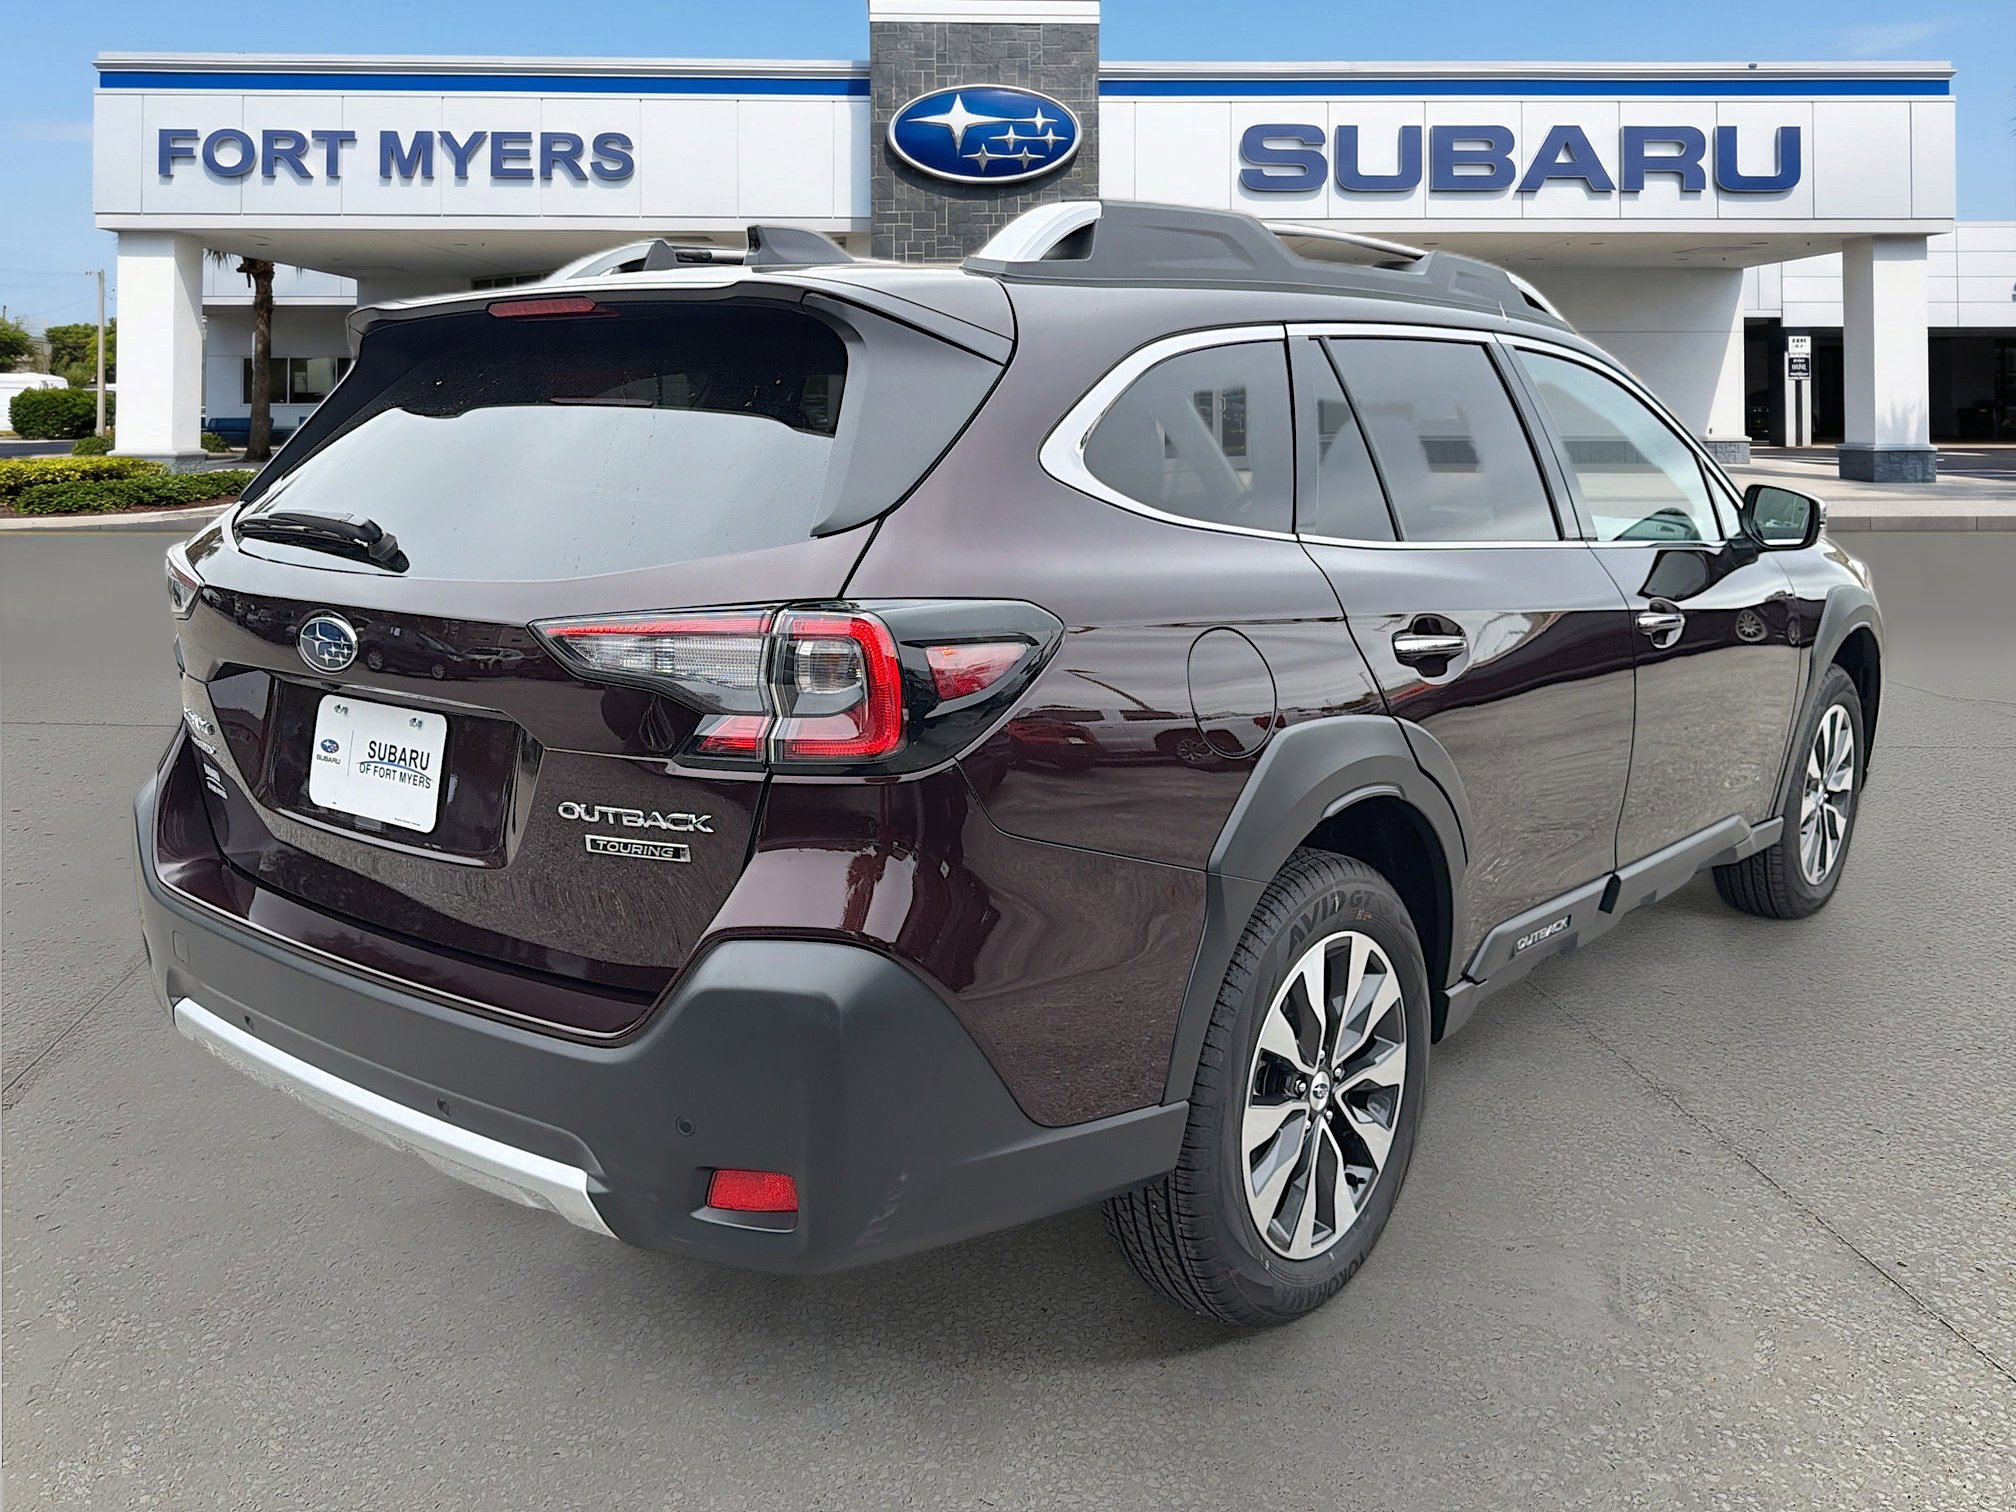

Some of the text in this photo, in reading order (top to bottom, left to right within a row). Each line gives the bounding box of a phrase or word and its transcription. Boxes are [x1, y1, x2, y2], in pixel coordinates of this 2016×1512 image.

[158, 128, 635, 180] FORT MYERS
[1240, 124, 1801, 193] SUBARU
[316, 754, 341, 764] SUBARU
[367, 740, 431, 771] SUBARU
[359, 762, 431, 789] OF FORT MYERS
[556, 800, 714, 834] OUTBACK
[595, 840, 674, 858] TOURING
[1287, 890, 1347, 960] AVID
[1516, 916, 1569, 950] OUTBACK
